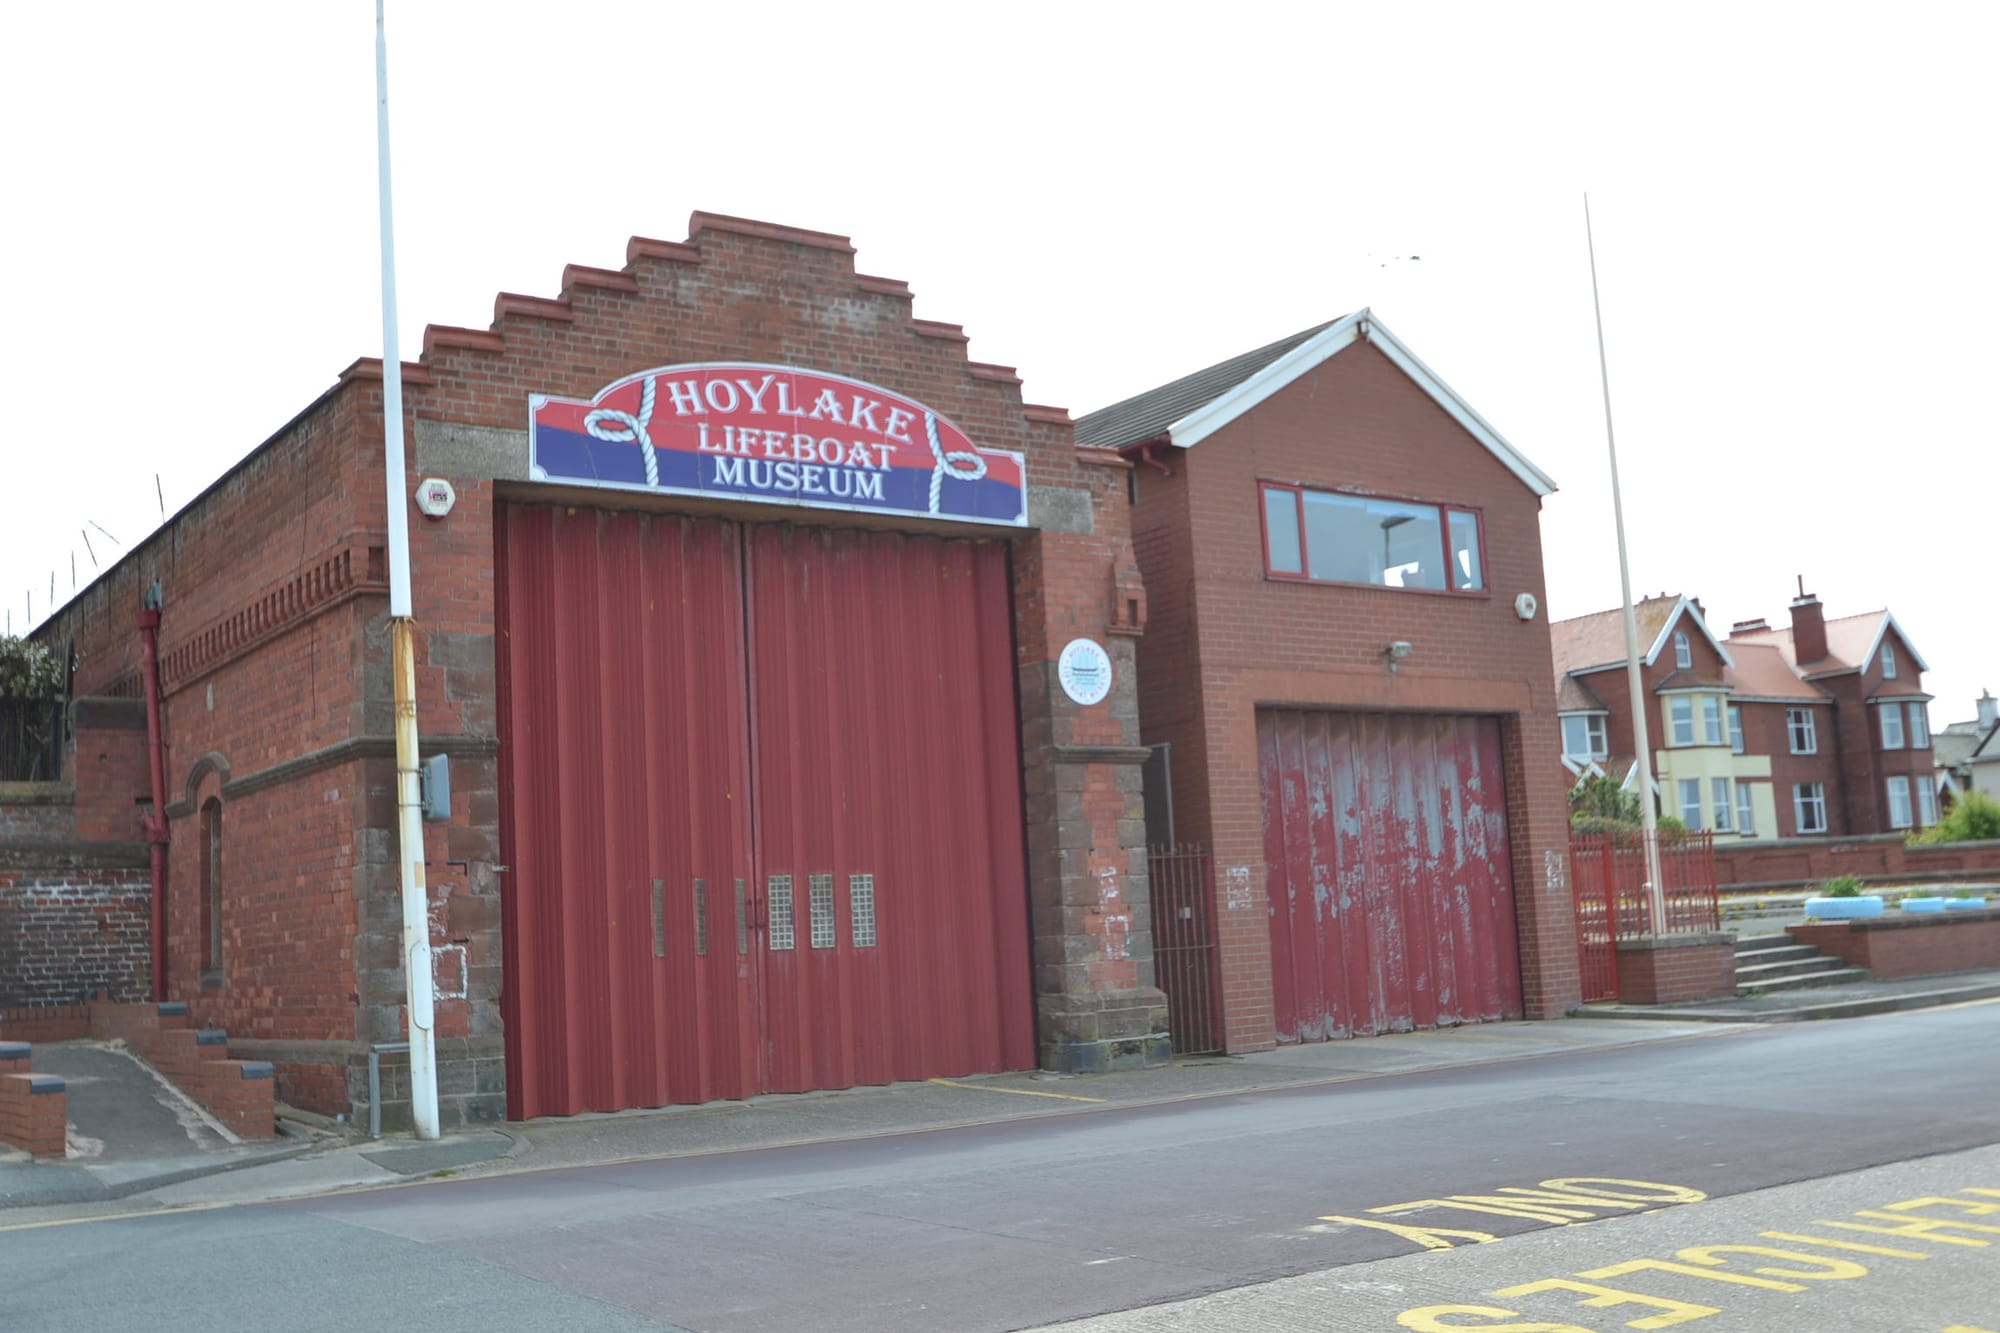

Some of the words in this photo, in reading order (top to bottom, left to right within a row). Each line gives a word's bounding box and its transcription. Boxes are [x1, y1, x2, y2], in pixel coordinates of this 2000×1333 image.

[666, 375, 915, 443] HOYLAKE
[698, 423, 897, 472] LIFEBOAT
[713, 456, 886, 501] MUSEUM
[1316, 1177, 1707, 1252] ONLY
[1395, 1187, 2000, 1333] EHICLES
